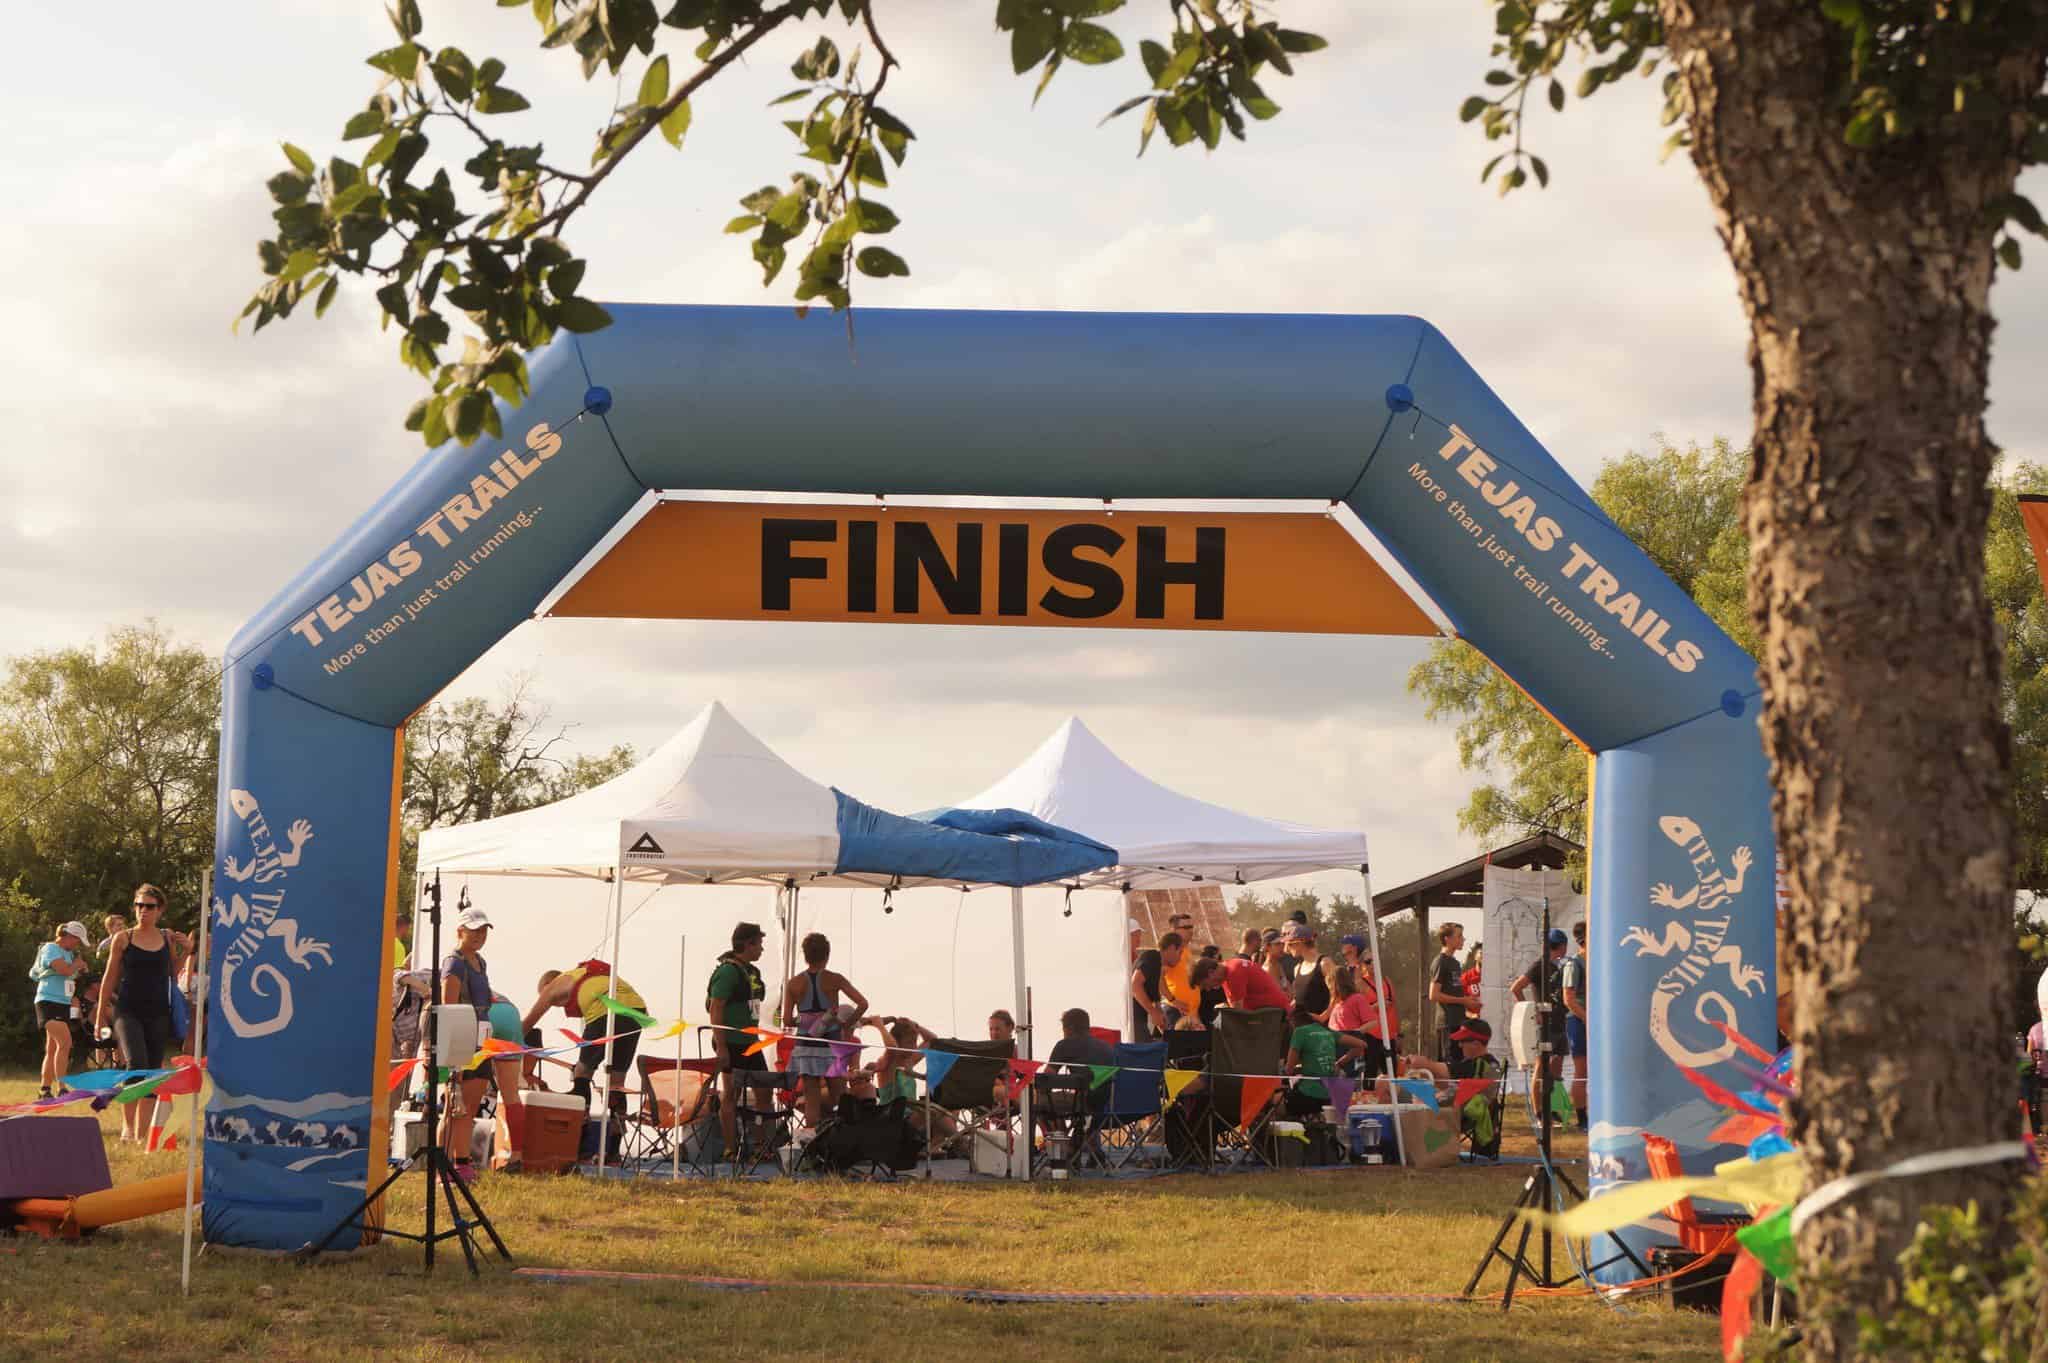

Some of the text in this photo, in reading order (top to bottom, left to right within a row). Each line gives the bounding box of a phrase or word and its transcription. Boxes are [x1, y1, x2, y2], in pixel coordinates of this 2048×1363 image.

[291, 422, 563, 648] TEJAS TRAILS
[761, 518, 1226, 620] FINISH
[1408, 462, 1448, 503] More
[1447, 500, 1483, 538] than
[1477, 534, 1515, 569] just
[1514, 564, 1549, 599] trail
[1438, 423, 1704, 673] TEJAS TRAILS
[323, 640, 367, 676] More
[365, 612, 405, 644] than
[404, 586, 438, 621] just
[437, 559, 472, 593] trail
[248, 808, 287, 883] TEJAS
[1688, 833, 1733, 910] TEJAS
